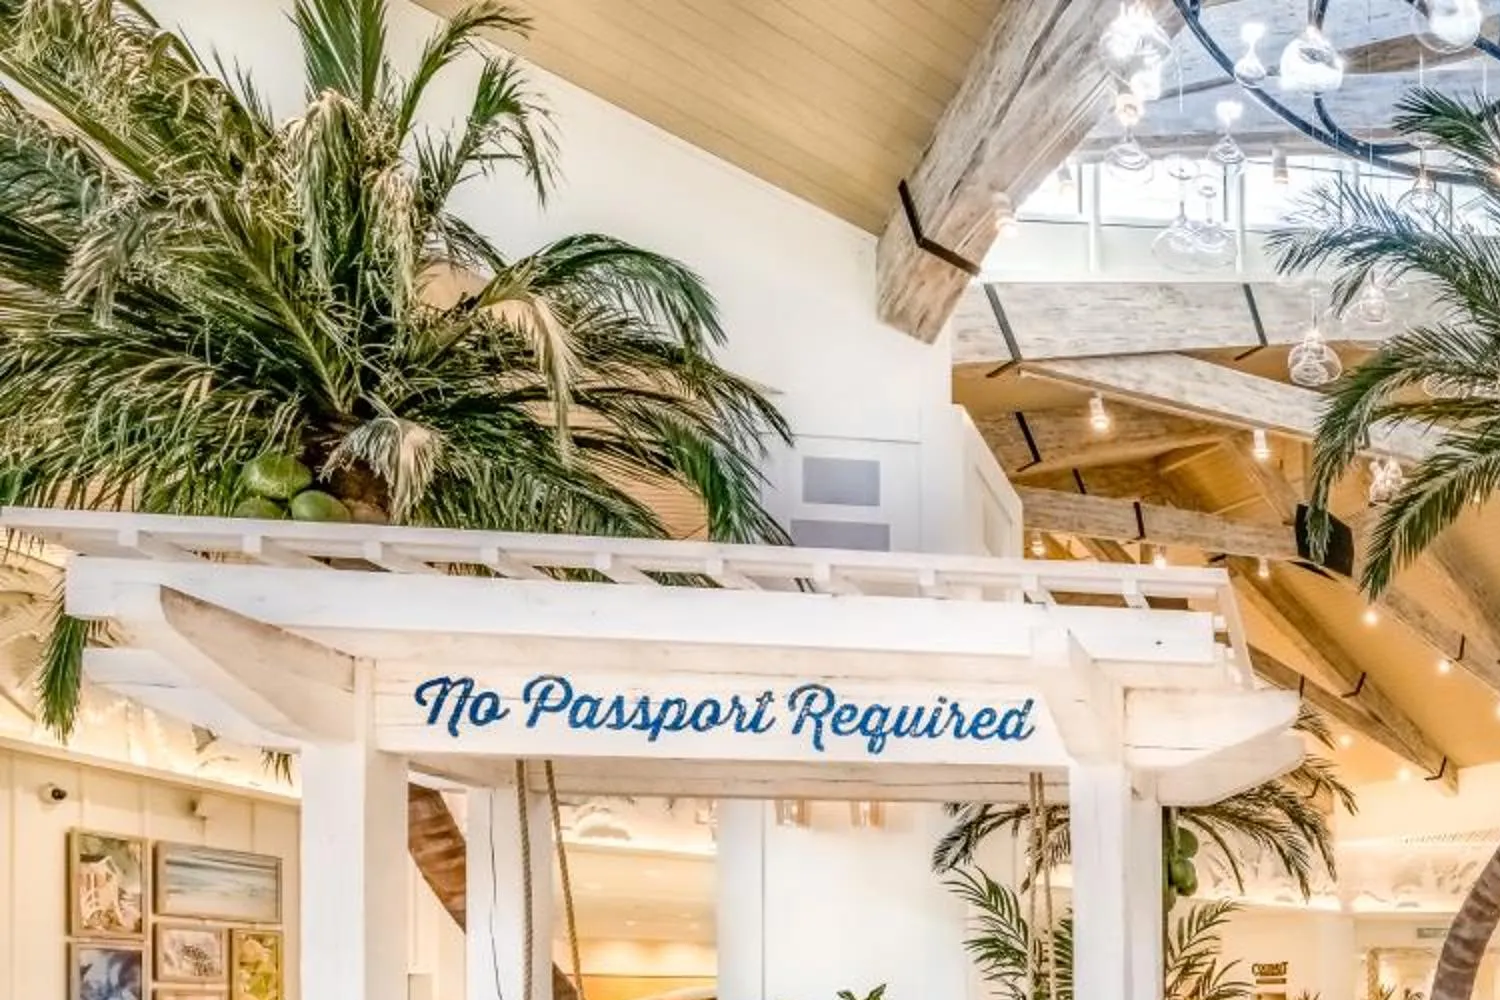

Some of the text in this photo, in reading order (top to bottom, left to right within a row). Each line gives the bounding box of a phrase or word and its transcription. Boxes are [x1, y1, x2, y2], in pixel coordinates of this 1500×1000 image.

[414, 674, 1035, 755] No Passport Required
